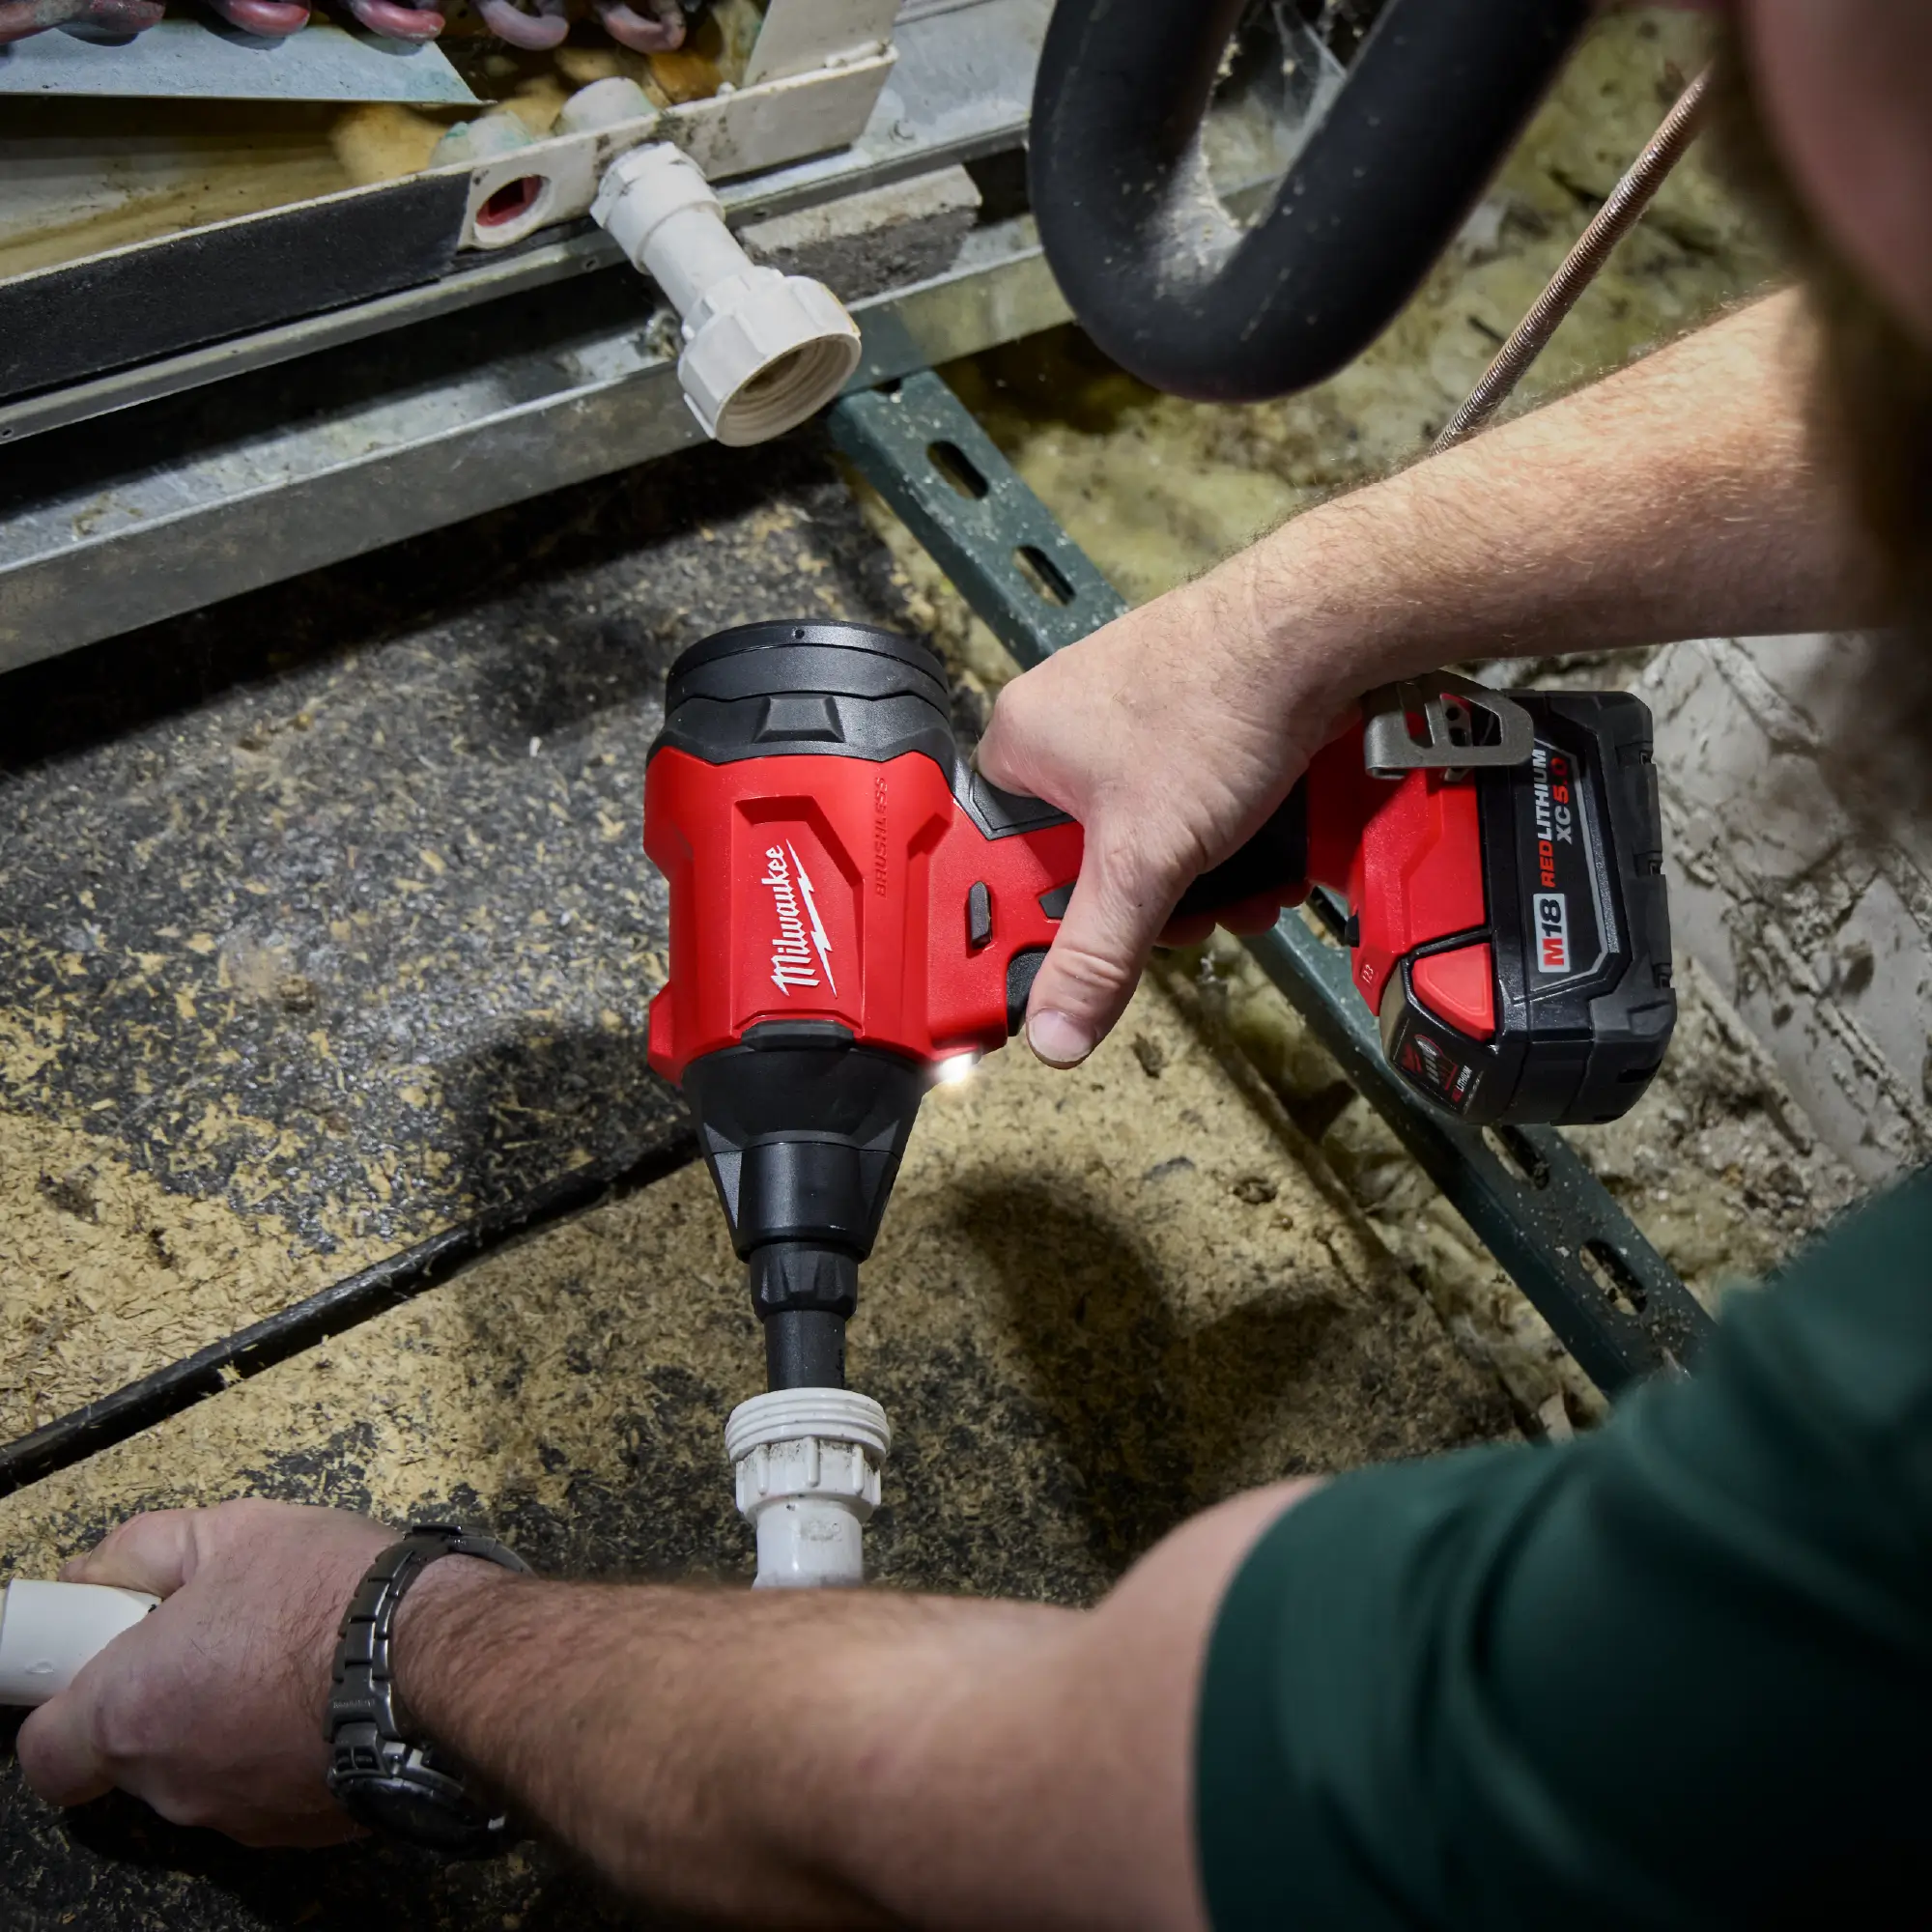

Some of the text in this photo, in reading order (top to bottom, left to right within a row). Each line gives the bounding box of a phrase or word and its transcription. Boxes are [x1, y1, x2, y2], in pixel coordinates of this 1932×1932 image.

[873, 777, 889, 899] BRUSHLESS
[1532, 749, 1565, 967] M18 REDLITHIUM
[1549, 756, 1573, 845] XC5.0
[760, 844, 821, 997] Milwaukee
[1451, 1065, 1473, 1103] LITHIUM
